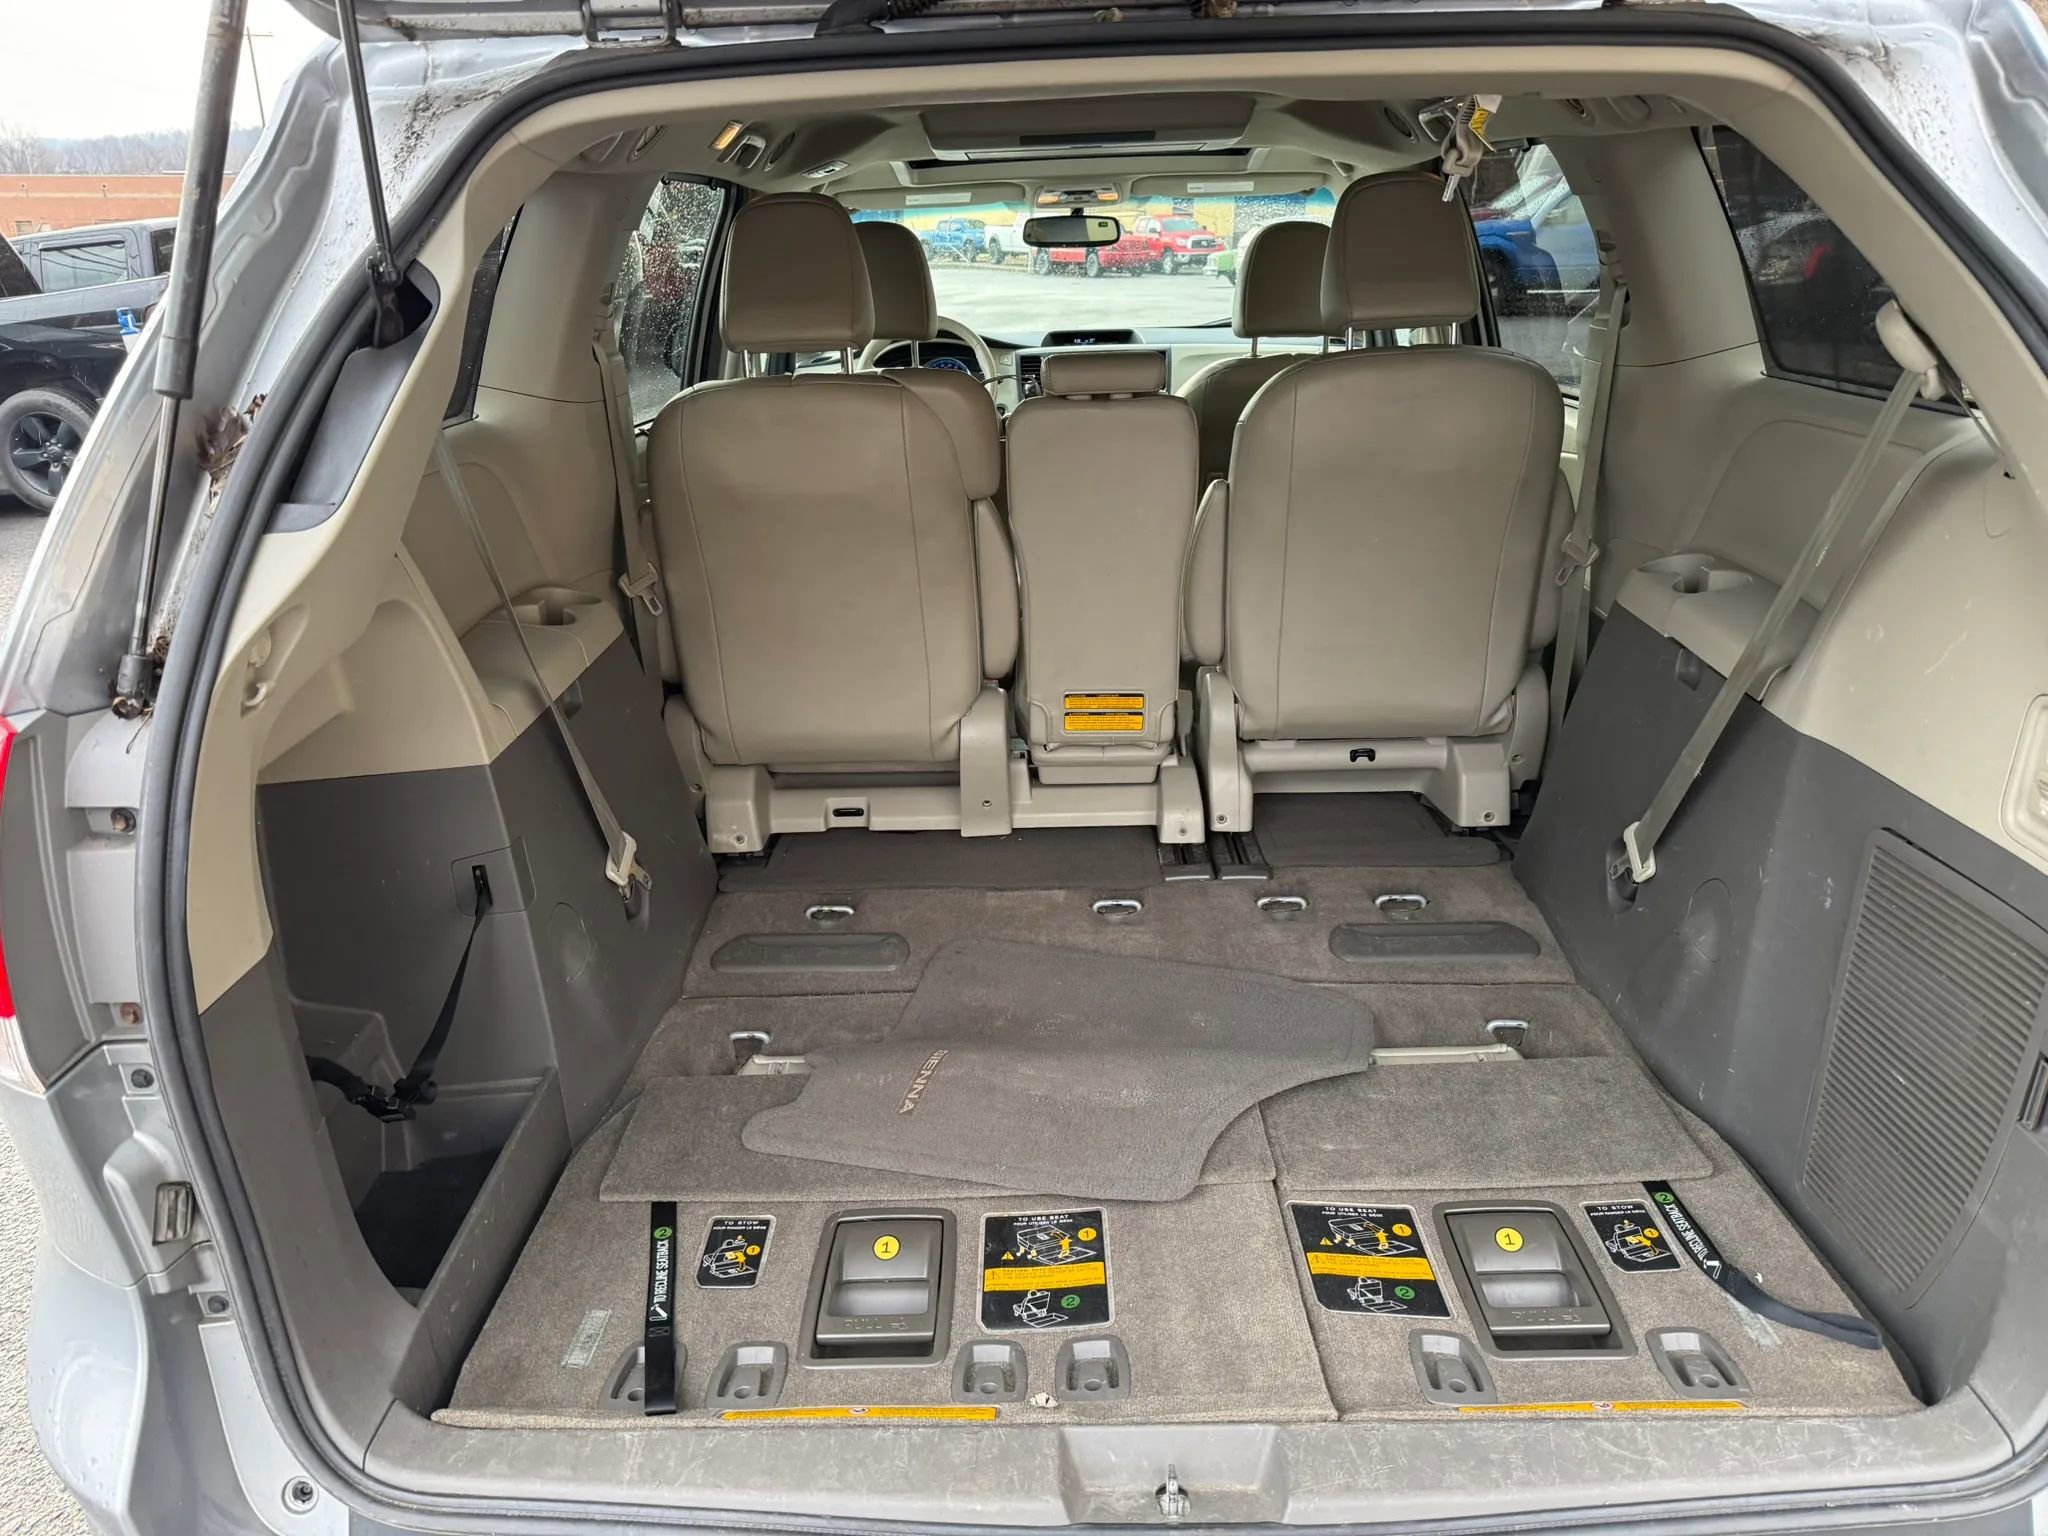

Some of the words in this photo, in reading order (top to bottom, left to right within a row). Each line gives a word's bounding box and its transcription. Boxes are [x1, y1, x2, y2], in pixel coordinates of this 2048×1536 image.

[899, 1049, 950, 1113] SIENNA
[1663, 1203, 1691, 1231] SEATBACK
[880, 1241, 891, 1254] 1
[1503, 1233, 1516, 1246] 1
[1681, 1229, 1707, 1255] RECLINE
[656, 1239, 670, 1270] SEATBACK
[654, 1269, 669, 1296] RECLINE
